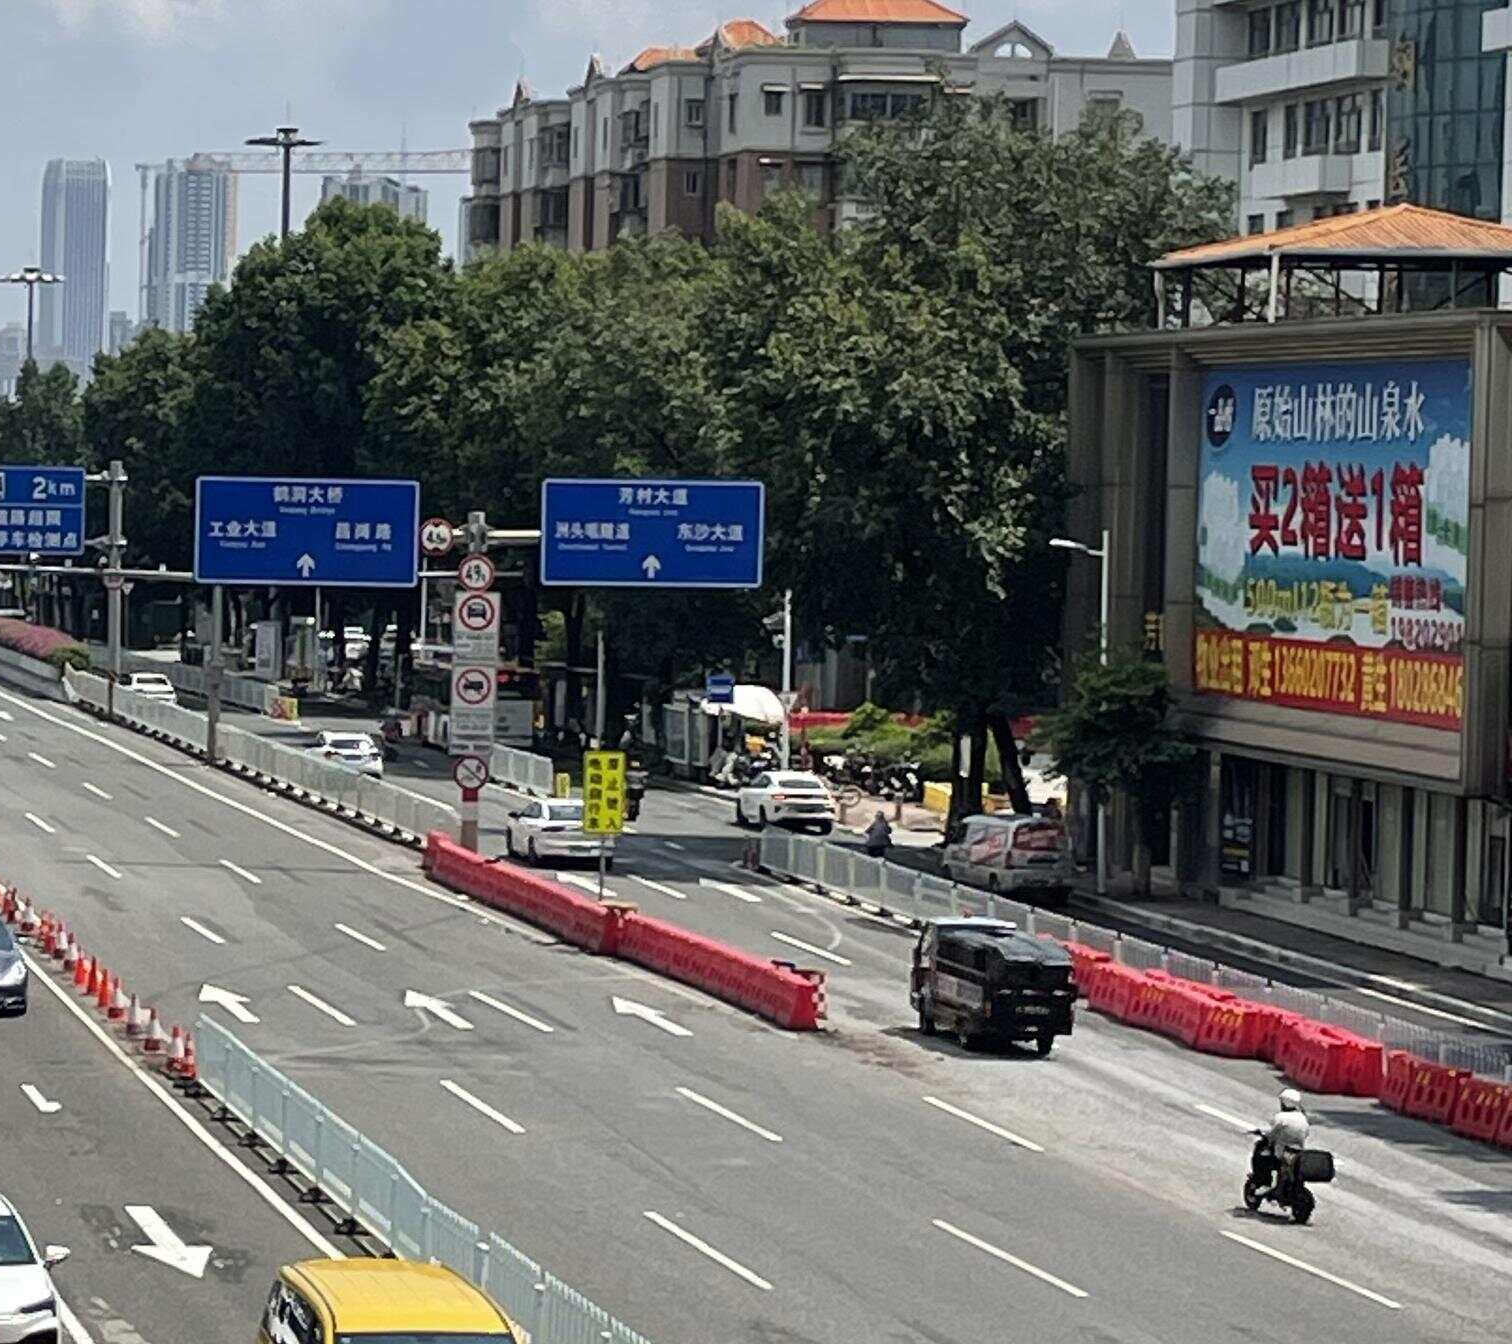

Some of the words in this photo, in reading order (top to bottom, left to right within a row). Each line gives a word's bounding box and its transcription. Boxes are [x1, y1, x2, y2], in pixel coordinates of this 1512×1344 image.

[1252, 380, 1426, 442] 原始山林的山泉水
[208, 520, 277, 538] 工业大道
[676, 523, 744, 542] 东沙大道
[1248, 460, 1425, 567] 买2箱送1箱
